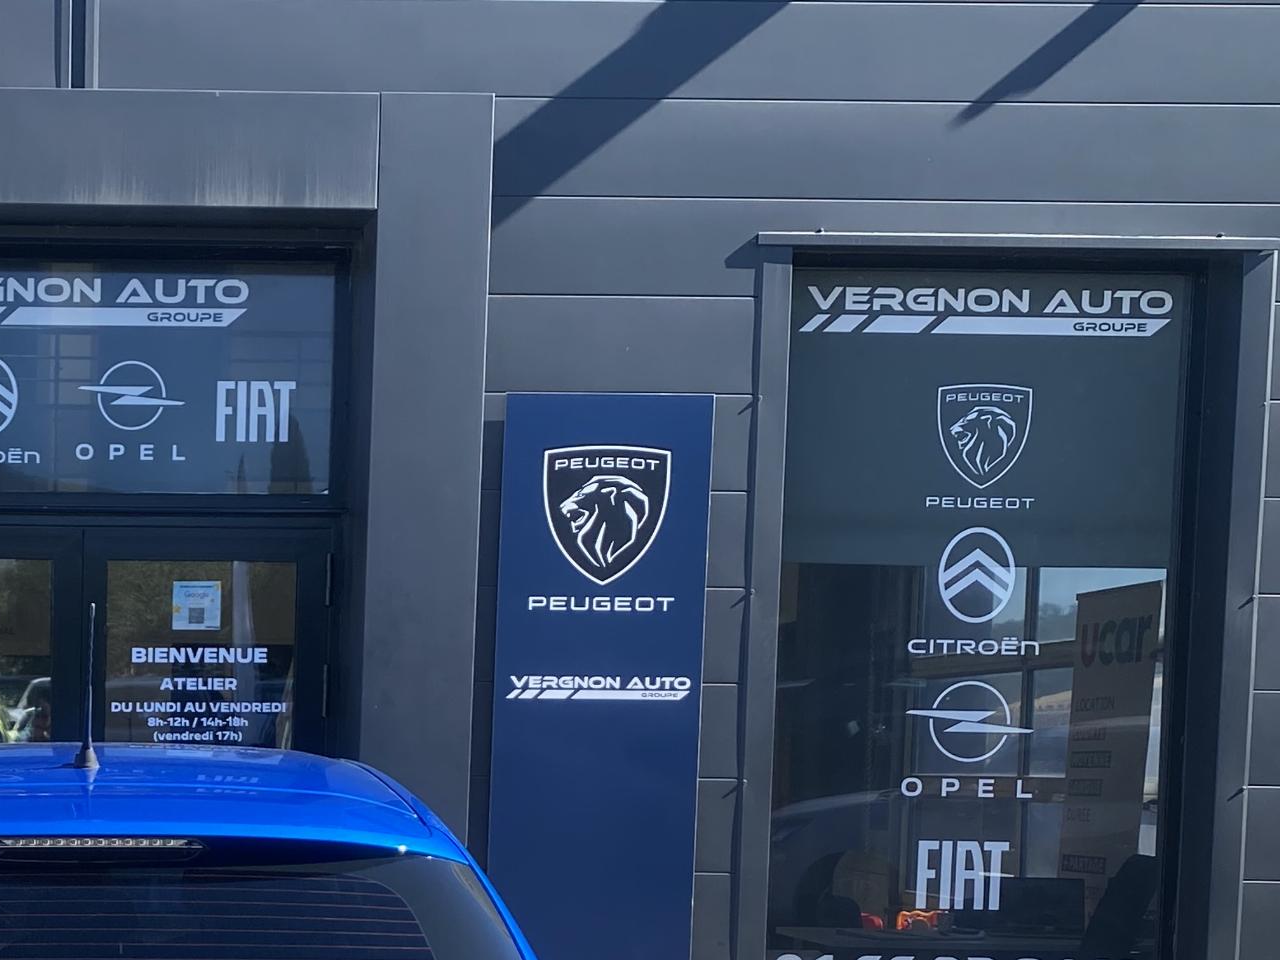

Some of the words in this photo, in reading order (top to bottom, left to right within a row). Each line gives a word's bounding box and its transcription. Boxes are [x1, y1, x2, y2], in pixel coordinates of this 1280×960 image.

[115, 278, 250, 305] AUTO
[807, 285, 1031, 313] VERGNON
[1042, 289, 1174, 315] AUTO
[146, 312, 224, 323] GROUPE
[1072, 321, 1148, 333] GROUPE
[945, 391, 1025, 404] PEUGEOT
[215, 380, 297, 442] FIAT
[75, 443, 186, 462] OPEL
[554, 457, 660, 470] PEUGEOT
[925, 496, 1035, 509] PEUGEOT
[528, 596, 675, 612] PEUGEOT
[907, 637, 1040, 656] CITROËN
[131, 647, 268, 664] BIENVENUE
[160, 677, 238, 691] ATELIER
[510, 675, 620, 690] VERGNON
[626, 676, 692, 690] AUTO
[111, 702, 133, 713] DU
[136, 702, 181, 713] LUNDI
[184, 702, 207, 713] AU
[209, 702, 286, 713] VENDREDI
[147, 717, 190, 727] 8h-12h
[200, 716, 249, 727] 14h-18h
[153, 731, 213, 742] (vendredi
[217, 731, 243, 742] 17h)
[901, 777, 1033, 799] OPEL
[915, 840, 1010, 911] FIAT
